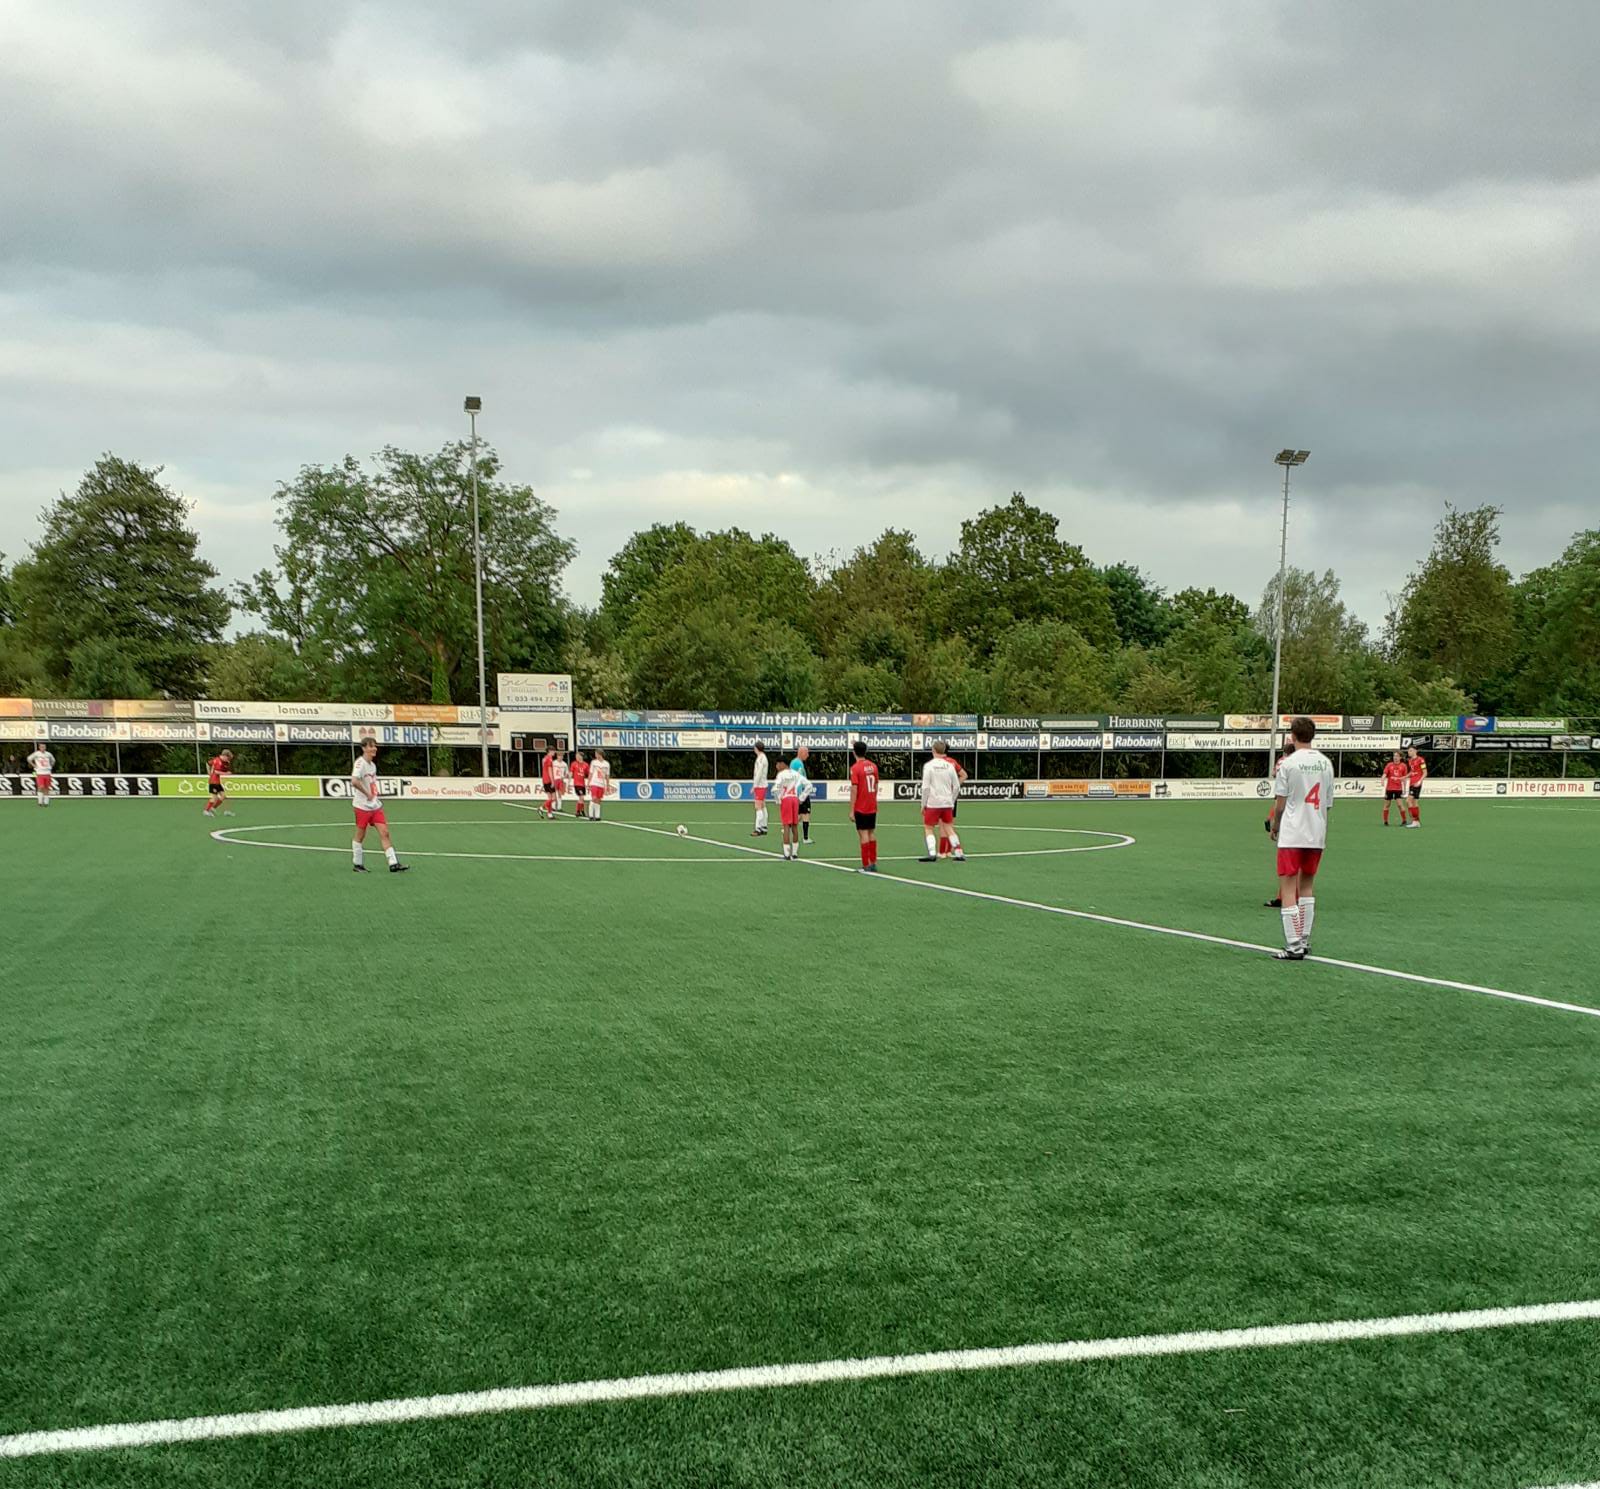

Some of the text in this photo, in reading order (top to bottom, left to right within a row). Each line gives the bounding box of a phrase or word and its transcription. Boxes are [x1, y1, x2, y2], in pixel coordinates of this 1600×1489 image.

[33, 701, 88, 710] WITTENBERG
[199, 704, 241, 713] lomans
[278, 705, 319, 715] lomans
[719, 712, 847, 726] www.interhiva.nl
[1390, 718, 1451, 728] www.trilo.com
[51, 724, 116, 737] Rabobank
[131, 725, 195, 738] Rabobank
[212, 726, 273, 739] Rabobank
[290, 727, 350, 740] Rabobank
[383, 727, 399, 743] DE
[403, 727, 434, 743] HOEF
[795, 735, 847, 747] Rabobank
[989, 736, 1038, 748] Rabobank
[1052, 736, 1101, 747] Rabobank
[1115, 736, 1162, 747] Rabobank
[1194, 737, 1254, 747] www.fix-it.nl
[411, 786, 439, 796] Quality
[441, 787, 472, 797] Catering
[499, 784, 528, 794] RODA
[1511, 782, 1585, 795] Intergamma
[1305, 782, 1321, 810] 4
